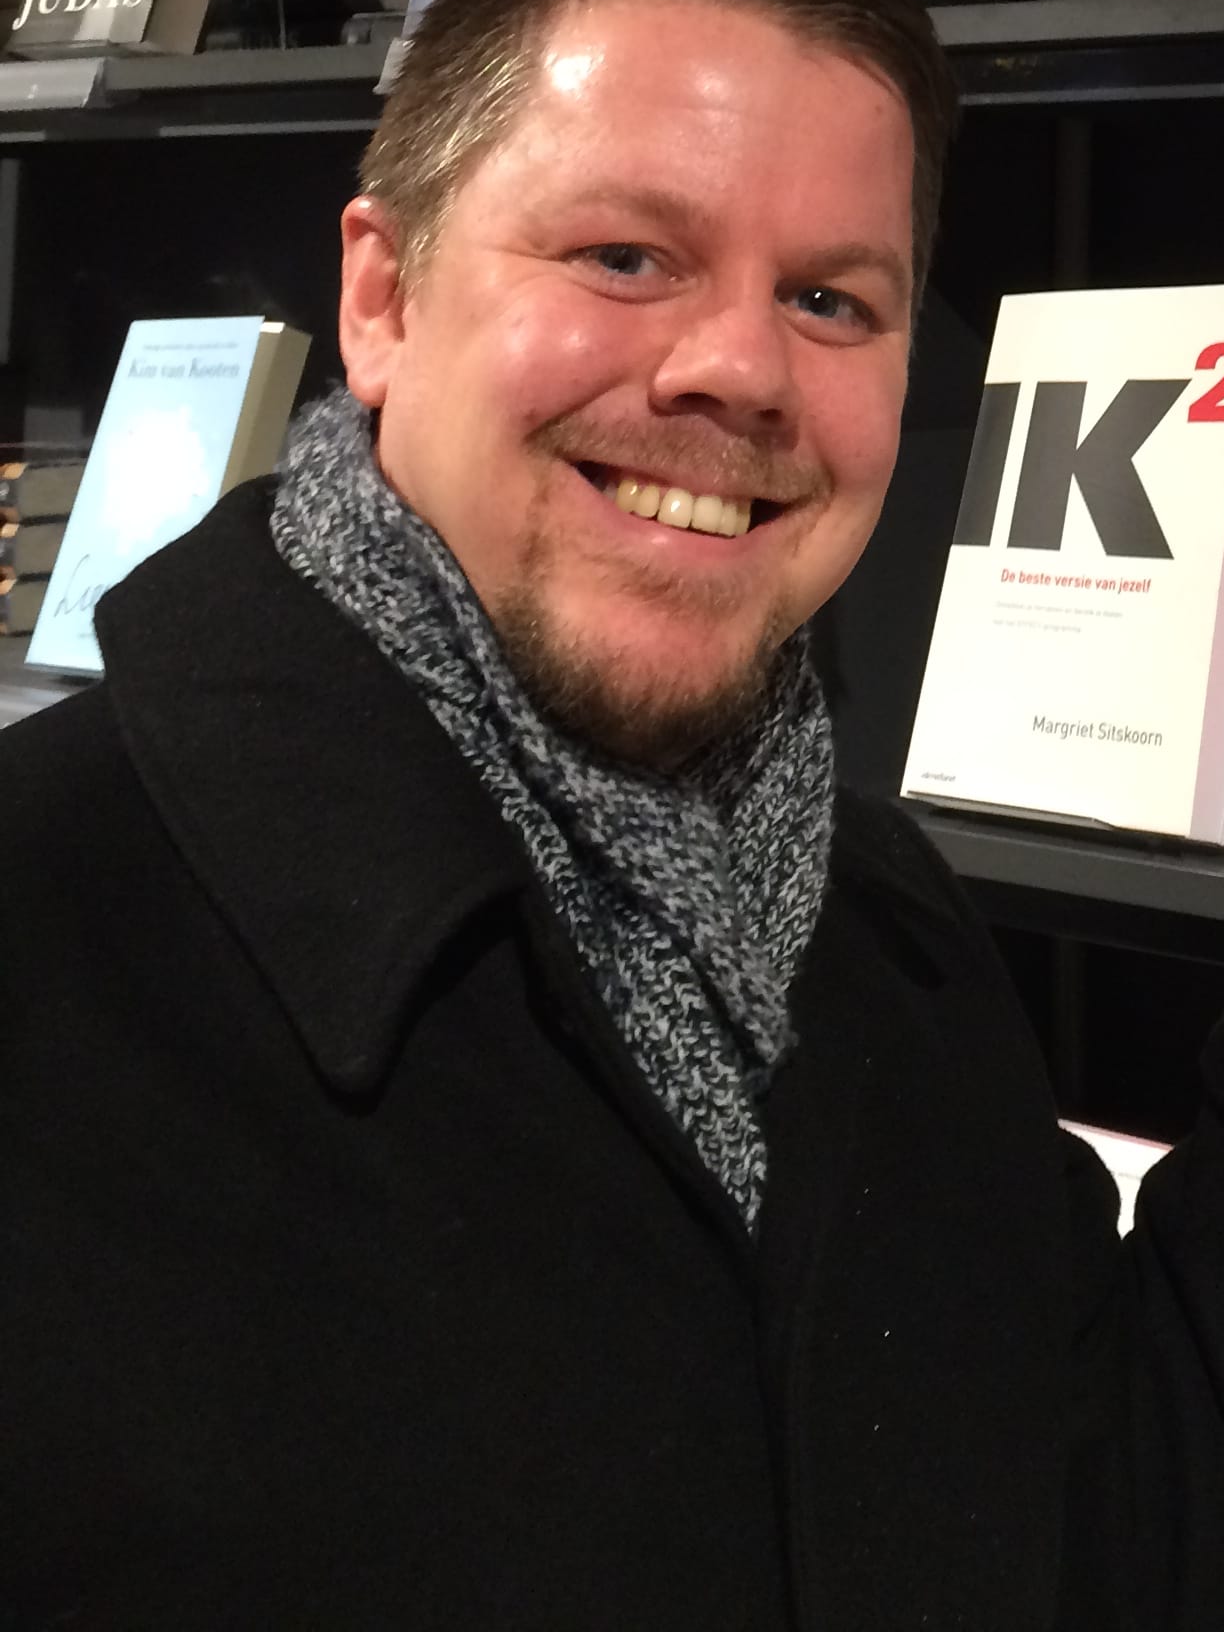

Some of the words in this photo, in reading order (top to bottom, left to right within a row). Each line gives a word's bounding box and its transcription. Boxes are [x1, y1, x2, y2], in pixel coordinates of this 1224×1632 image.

[1000, 567, 1016, 584] De
[1017, 570, 1052, 586] beste
[1054, 574, 1093, 590] versie
[1095, 578, 1117, 591] van
[1117, 577, 1152, 595] jezelf
[1032, 715, 1094, 741] Margriet
[1097, 721, 1163, 747] Sitskoorn
